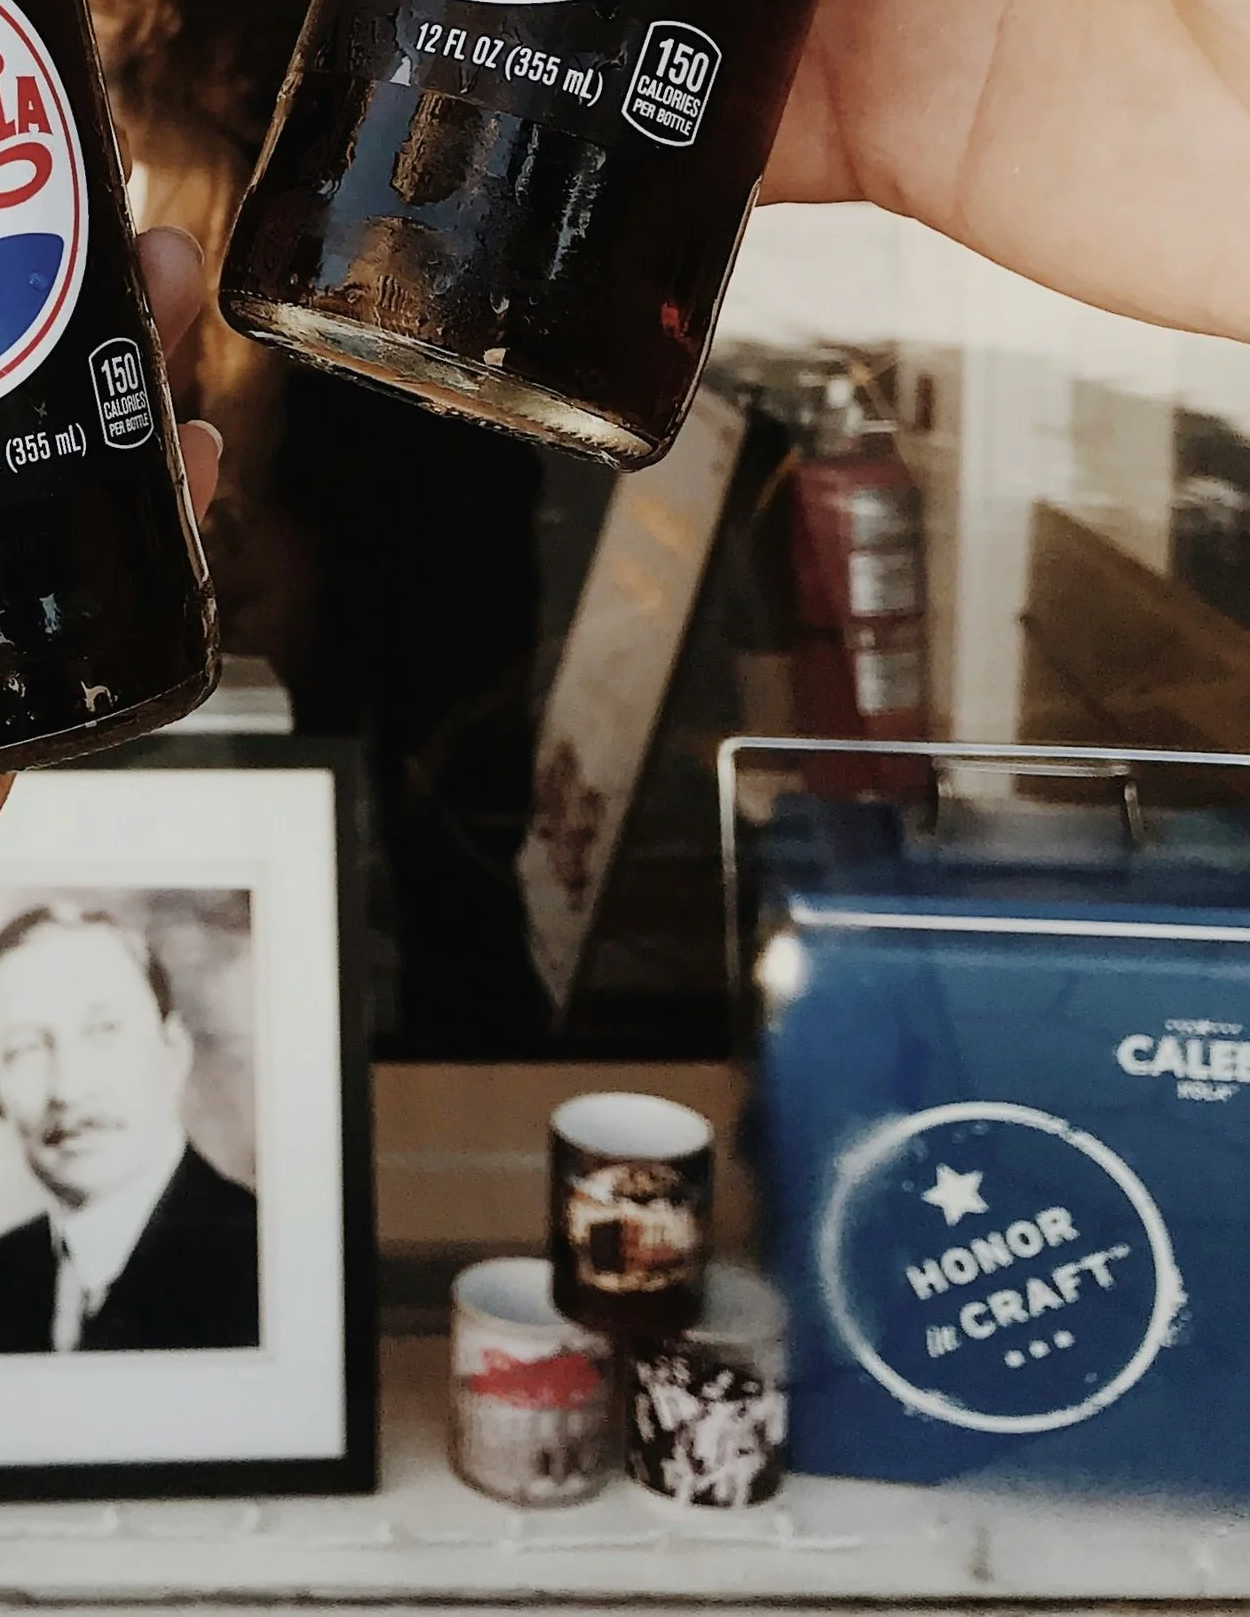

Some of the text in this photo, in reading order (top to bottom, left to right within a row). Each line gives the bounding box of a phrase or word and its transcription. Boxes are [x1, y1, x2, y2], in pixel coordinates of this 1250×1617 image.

[416, 22, 604, 108] 12 FL OZ (355 mL)
[655, 38, 710, 93] 150
[632, 97, 693, 136] PER BOTTLE
[636, 74, 701, 119] CALORIES
[102, 352, 139, 398] 150
[103, 390, 148, 421] CALORIES
[108, 412, 150, 438] PER BOTTLE
[6, 432, 52, 474] (355
[56, 422, 87, 458] mL)
[905, 1206, 1081, 1301] HONOR
[958, 1250, 1116, 1341] CRAFT
